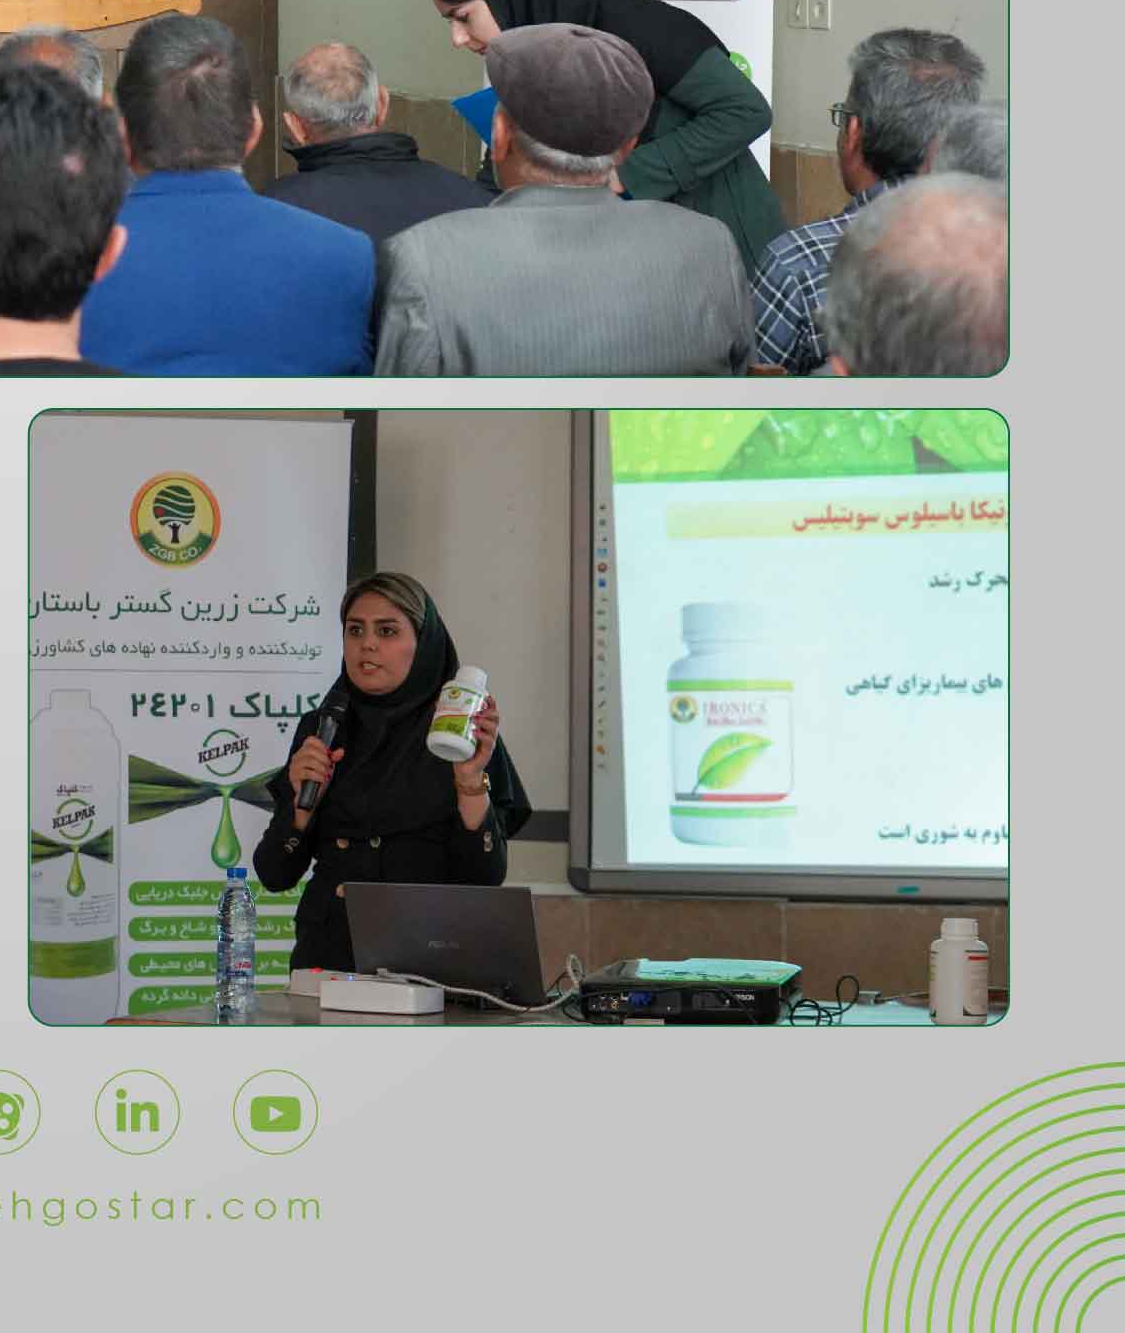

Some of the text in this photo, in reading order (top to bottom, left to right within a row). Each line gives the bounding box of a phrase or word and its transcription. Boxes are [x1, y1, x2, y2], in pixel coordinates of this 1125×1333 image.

[885, 501, 965, 530] باسیلوس
[148, 543, 175, 562] ZGB
[966, 570, 1008, 593] حرک
[109, 588, 173, 620] گستر
[180, 593, 239, 622] زرین
[247, 593, 322, 623] شرکت
[30, 638, 323, 660] تولیدکننده و واردکننده نهاده های کشاورز
[972, 673, 1004, 694] های
[198, 737, 250, 764] KELPAK
[981, 823, 1008, 845] اوم
